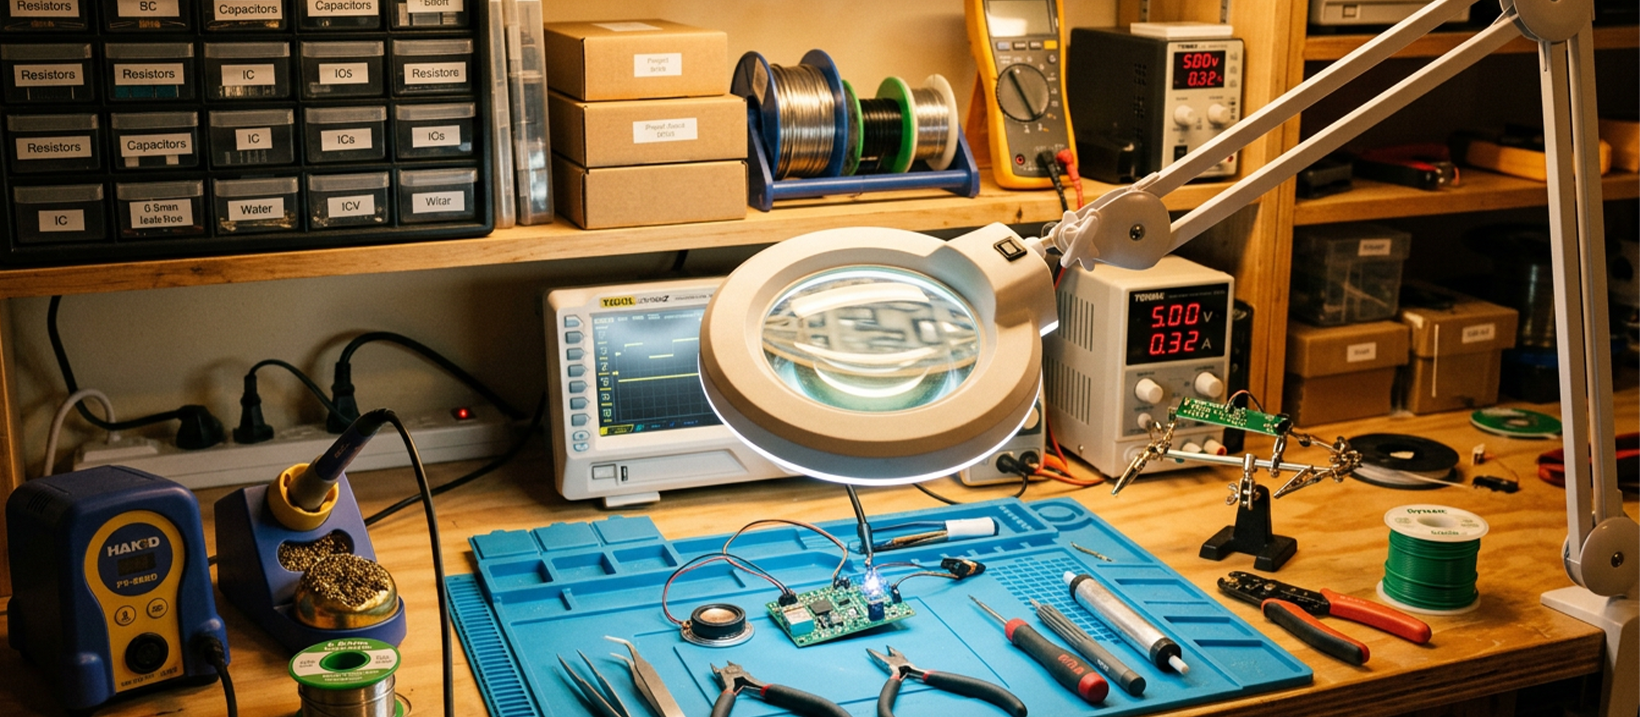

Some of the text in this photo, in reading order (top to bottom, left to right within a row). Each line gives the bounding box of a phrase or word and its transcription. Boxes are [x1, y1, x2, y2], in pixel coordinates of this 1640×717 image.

[315, 0, 372, 12] Capacitors
[21, 70, 76, 80] Resistors
[122, 68, 175, 80] Resistors
[242, 70, 255, 80] IC
[247, 133, 260, 144] IC
[337, 135, 355, 145] ICs
[27, 143, 82, 153] Resistors
[127, 139, 187, 152] Capacitors
[240, 204, 273, 215] Water
[341, 201, 361, 211] ICV
[54, 216, 68, 226] IC
[1151, 303, 1213, 328] 5.00 V
[1148, 331, 1212, 355] 0.32 A
